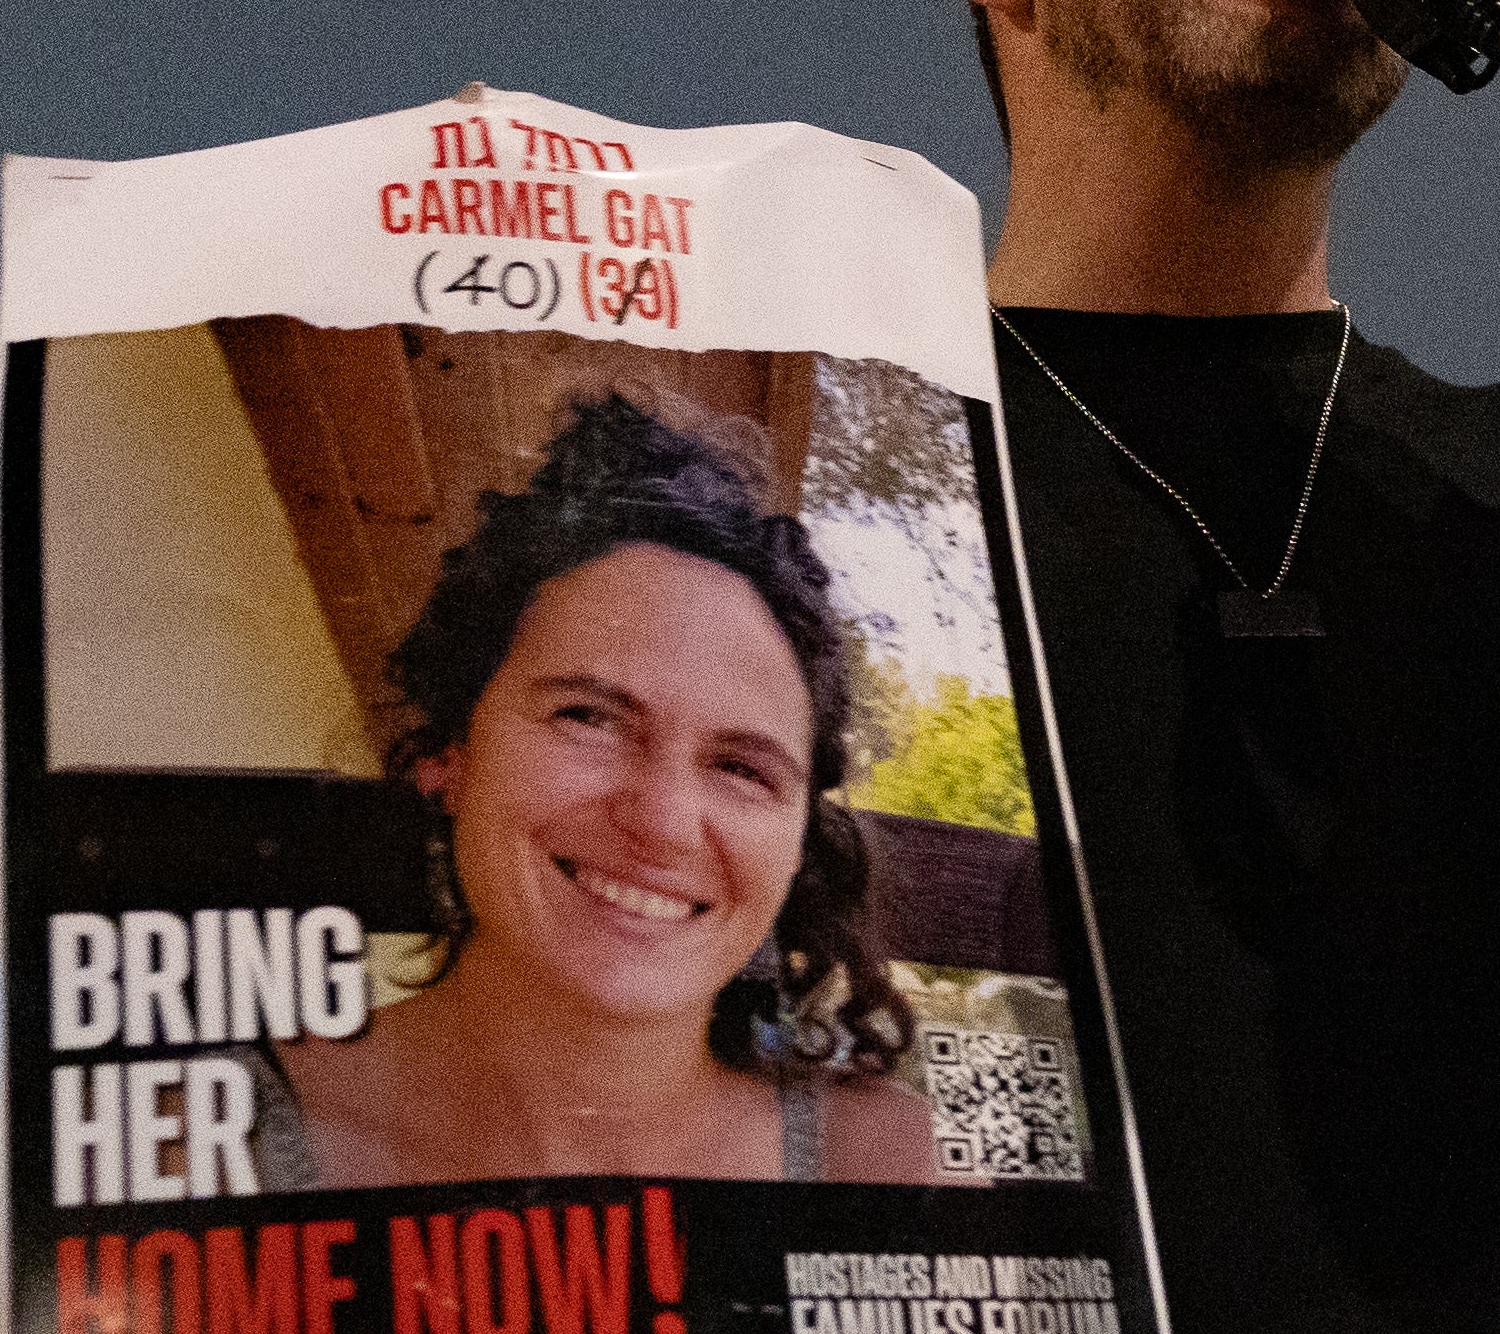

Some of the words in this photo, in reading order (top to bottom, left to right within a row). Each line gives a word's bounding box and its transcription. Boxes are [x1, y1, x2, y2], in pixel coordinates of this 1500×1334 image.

[429, 114, 497, 170] גת
[379, 179, 591, 245] CARMEL
[604, 188, 694, 255] GAT
[413, 250, 562, 323] (40)
[49, 906, 370, 1051] BRING
[53, 1058, 262, 1208] HER
[784, 1252, 931, 1299] HOSTAGES
[933, 1254, 991, 1299] AND
[992, 1255, 1114, 1301] MISSING
